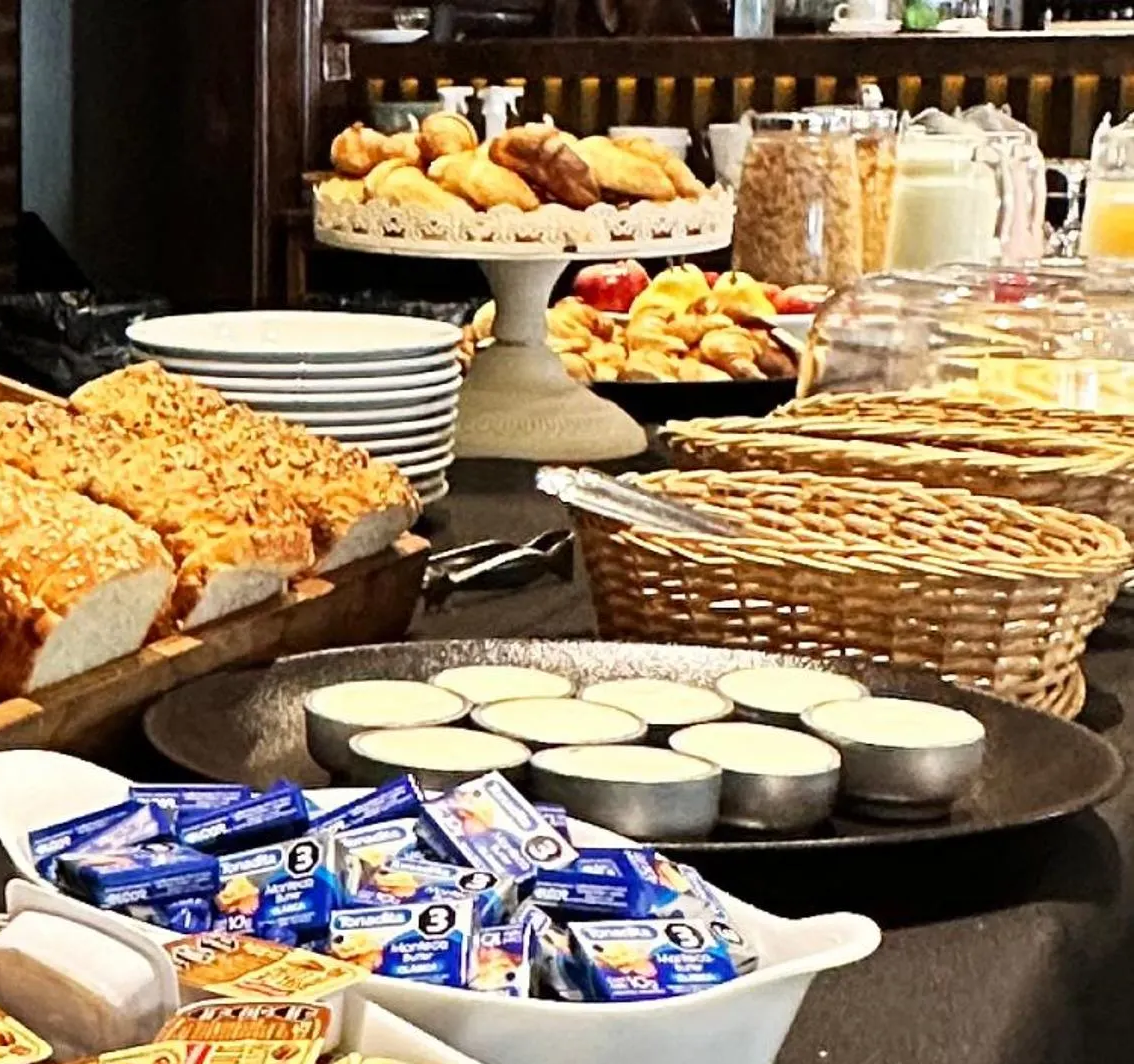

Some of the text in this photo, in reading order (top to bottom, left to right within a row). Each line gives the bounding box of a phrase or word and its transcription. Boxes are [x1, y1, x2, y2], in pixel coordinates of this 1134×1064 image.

[294, 845, 314, 872] 3
[426, 907, 449, 932] 3
[390, 940, 450, 952] Manteca
[674, 925, 700, 948] 3
